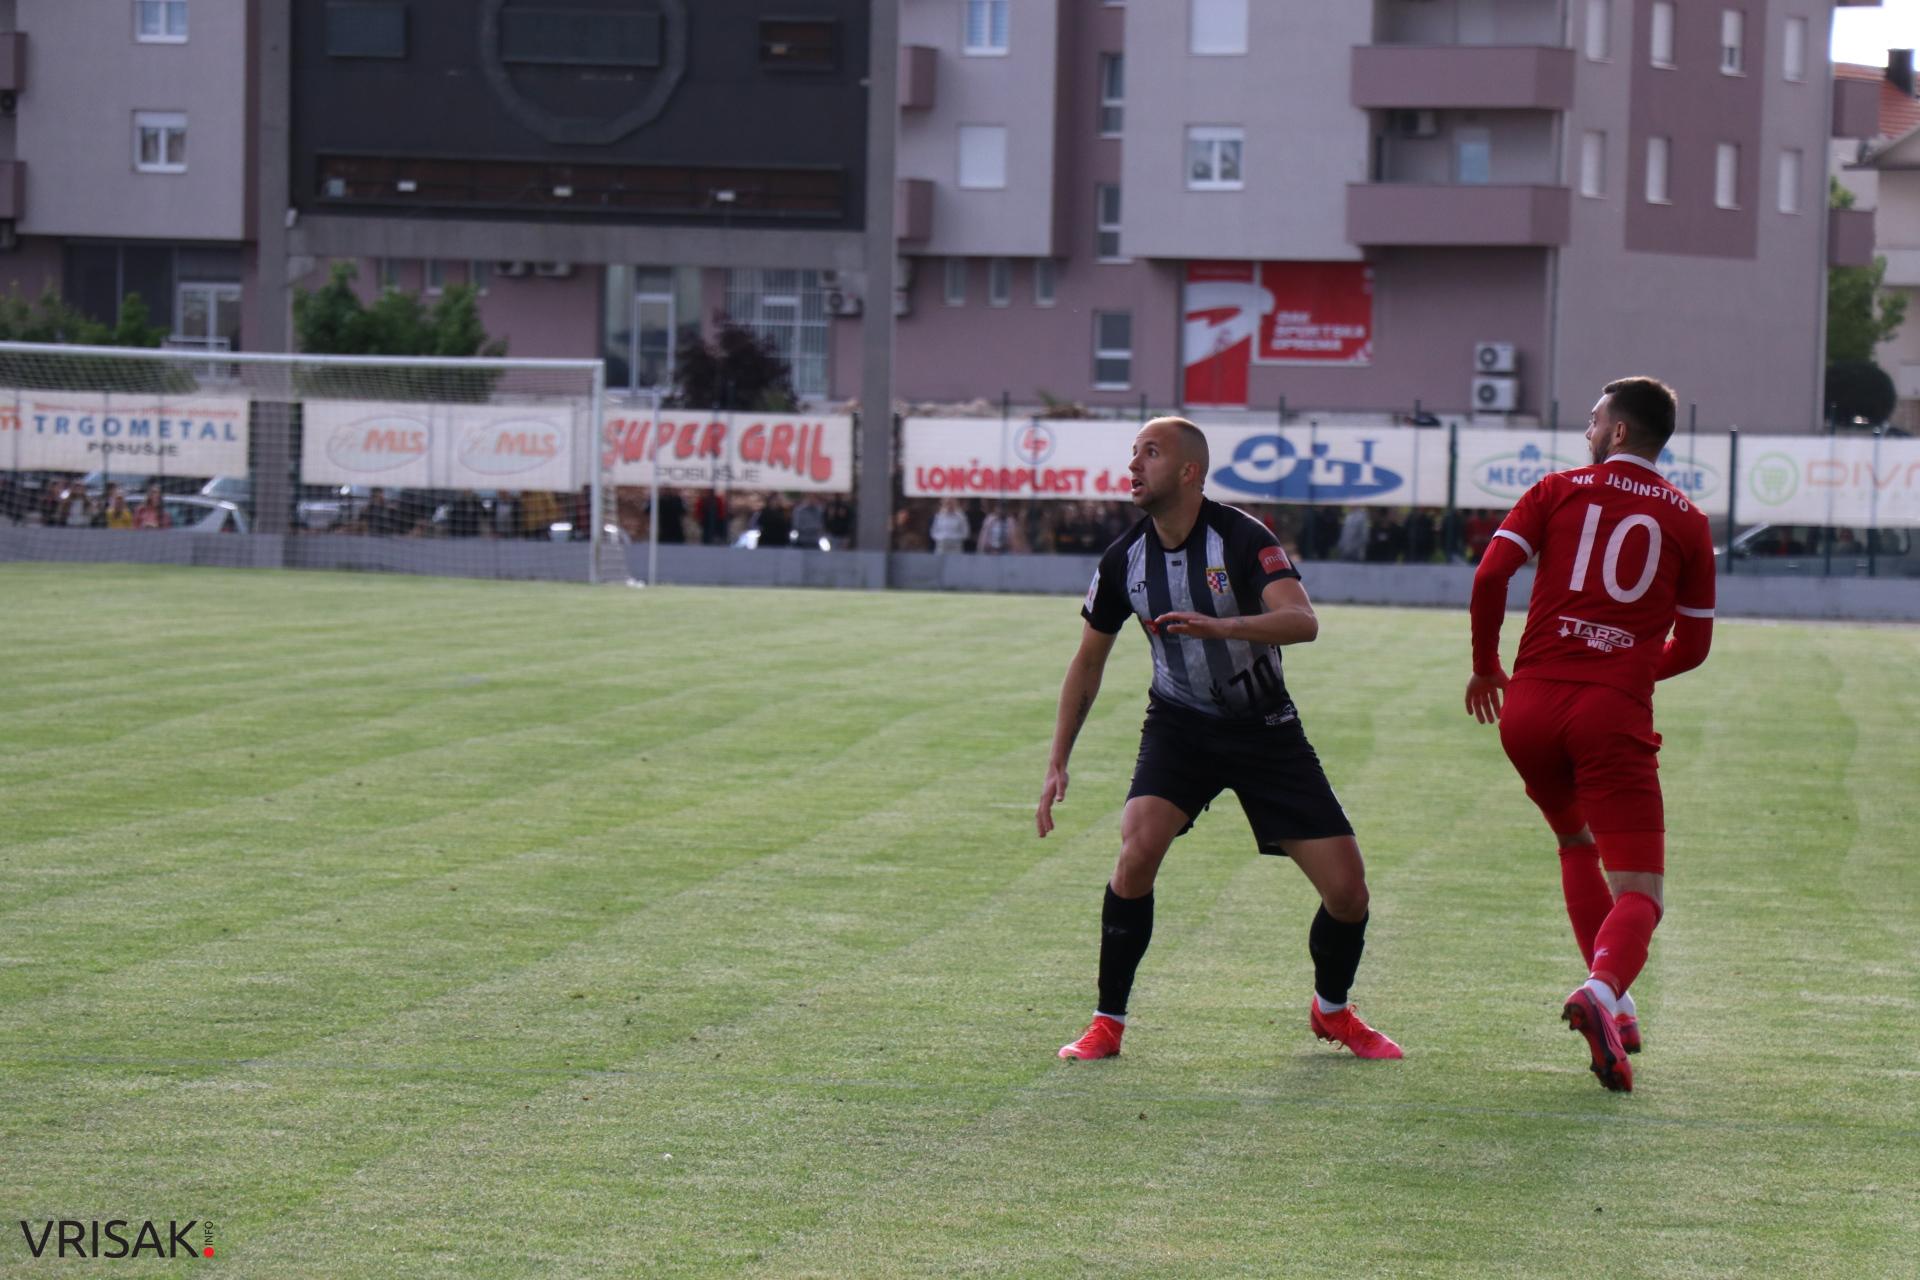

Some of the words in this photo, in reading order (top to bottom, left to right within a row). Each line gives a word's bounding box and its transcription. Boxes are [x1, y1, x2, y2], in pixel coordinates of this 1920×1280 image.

[33, 414, 236, 441] TRGOMETAL
[602, 419, 727, 471] SUPER
[740, 423, 832, 481] GRIL
[916, 457, 1086, 493] LONČARPLAST
[1571, 474, 1595, 485] NK
[1605, 473, 1689, 512] JEDINSTVO
[1569, 503, 1662, 603] 10
